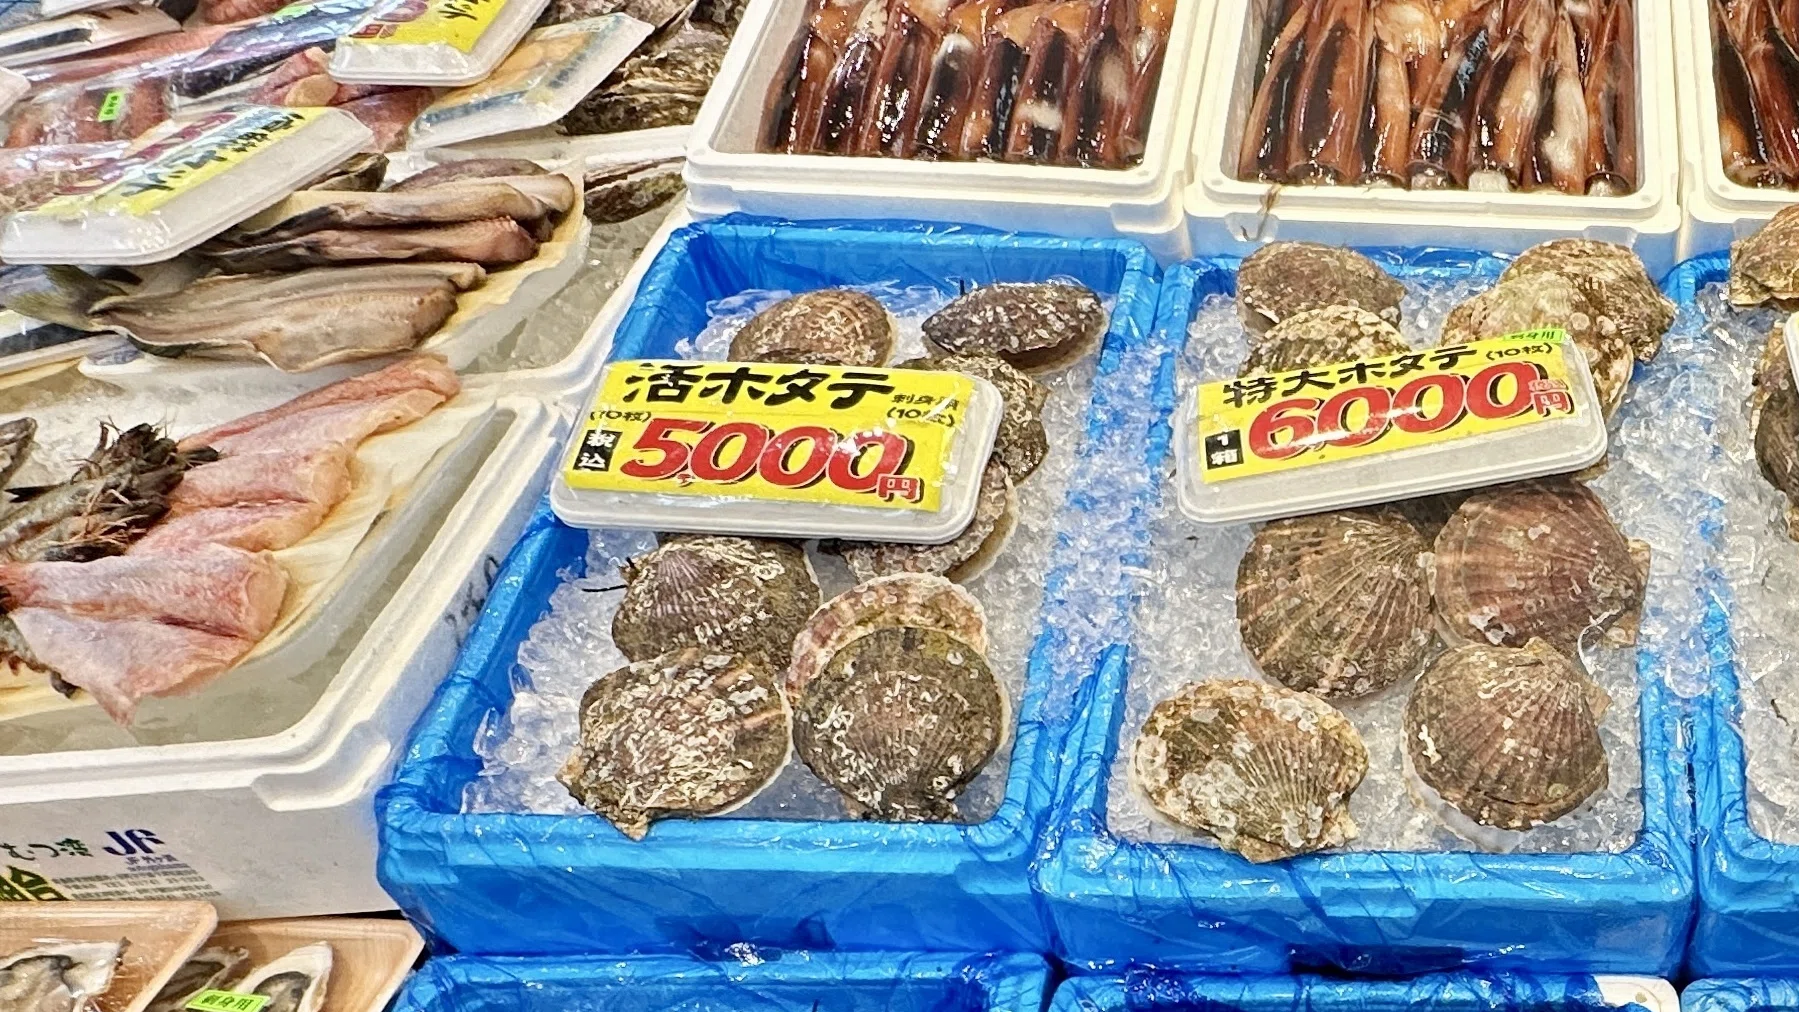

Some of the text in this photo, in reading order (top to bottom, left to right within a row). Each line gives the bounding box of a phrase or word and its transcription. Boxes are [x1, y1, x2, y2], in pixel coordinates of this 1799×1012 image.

[624, 362, 895, 409] 活ホタテ
[1223, 345, 1478, 408] 特大ホタテ
